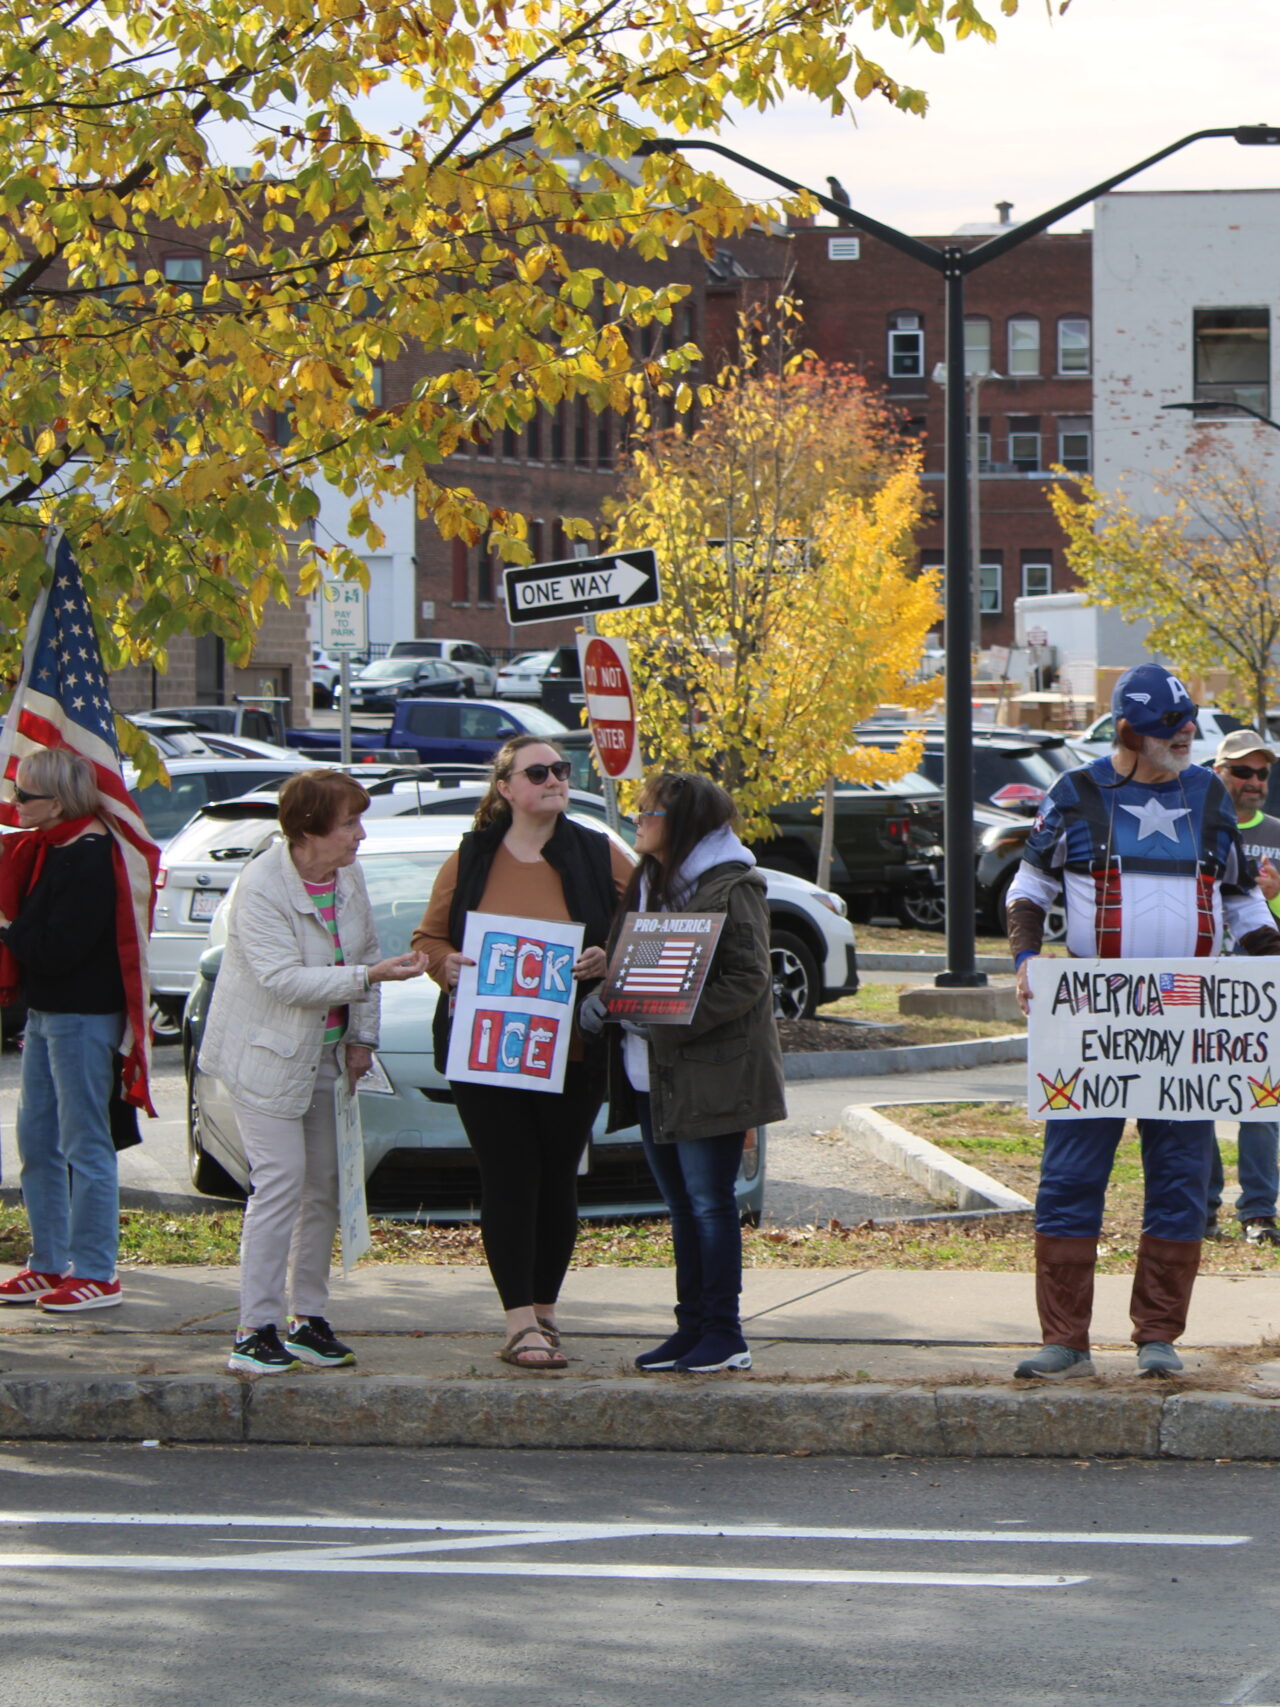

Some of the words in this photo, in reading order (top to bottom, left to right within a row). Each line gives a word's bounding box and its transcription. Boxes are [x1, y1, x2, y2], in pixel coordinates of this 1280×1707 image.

[522, 581, 564, 605] ONE
[570, 573, 613, 598] WAY
[331, 628, 355, 636] PARK
[337, 619, 349, 627] TO
[586, 666, 597, 687] DO
[602, 667, 622, 688] NOT
[1166, 676, 1190, 704] A
[596, 728, 626, 750] ENTER
[632, 918, 712, 933] PRO-AMERICA
[486, 942, 570, 992] FCK
[1051, 971, 1164, 1017] AMERICA
[1200, 974, 1278, 1023] NEEDS
[478, 1018, 553, 1069] ICE
[1081, 1025, 1185, 1066] EVERYDAY
[1191, 1028, 1269, 1065] HEROES
[1082, 1073, 1142, 1110] NOT
[1158, 1074, 1243, 1115] KINGS
